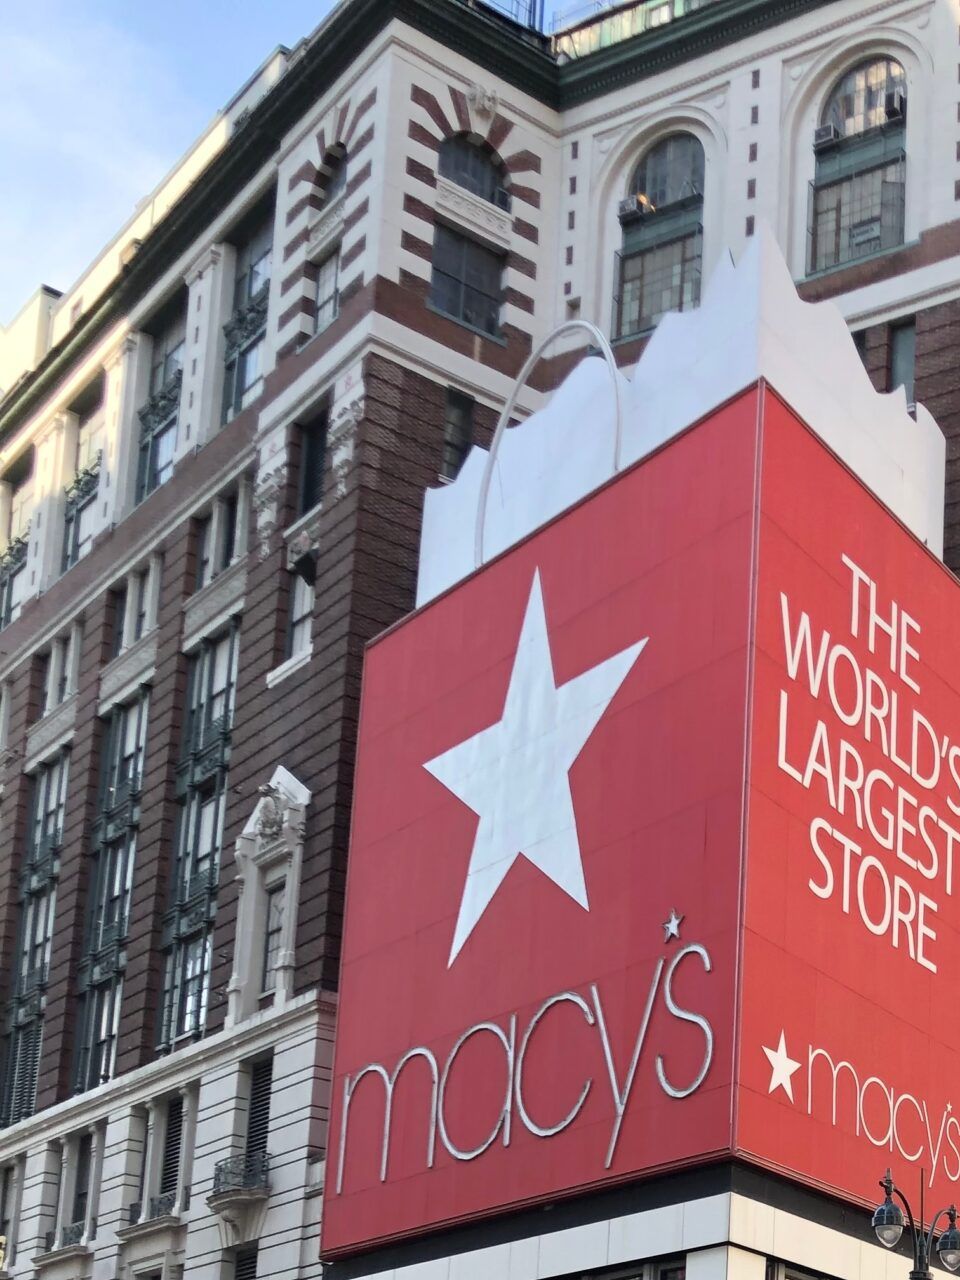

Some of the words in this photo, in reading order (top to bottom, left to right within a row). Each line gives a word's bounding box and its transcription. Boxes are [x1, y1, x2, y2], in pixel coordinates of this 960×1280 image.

[841, 552, 921, 695] THE
[808, 817, 938, 974] STORE
[335, 908, 714, 1195] macy's
